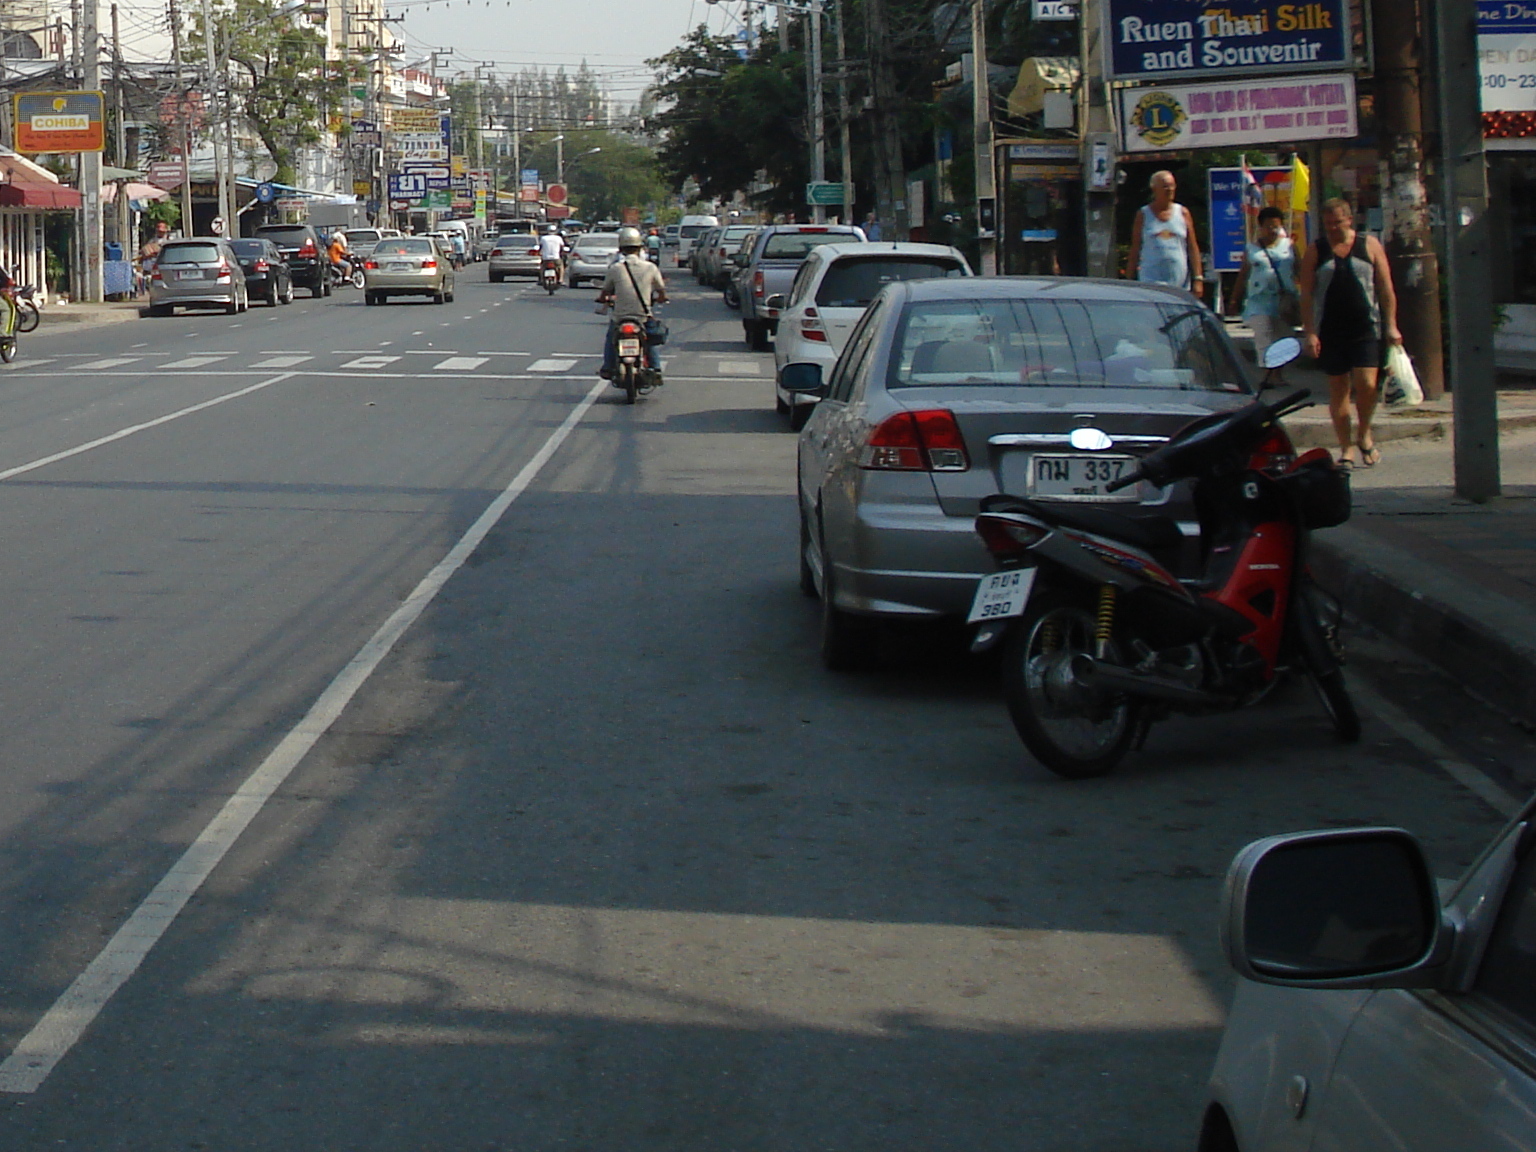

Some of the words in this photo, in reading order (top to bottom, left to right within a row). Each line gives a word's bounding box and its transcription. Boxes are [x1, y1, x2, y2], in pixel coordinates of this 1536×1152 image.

[1120, 15, 1194, 44] Ruen
[1196, 14, 1264, 38] Thai
[1276, 2, 1333, 32] Silk
[1143, 42, 1194, 70] and
[1201, 38, 1322, 67] Souvenir
[35, 118, 86, 128] COHIBA
